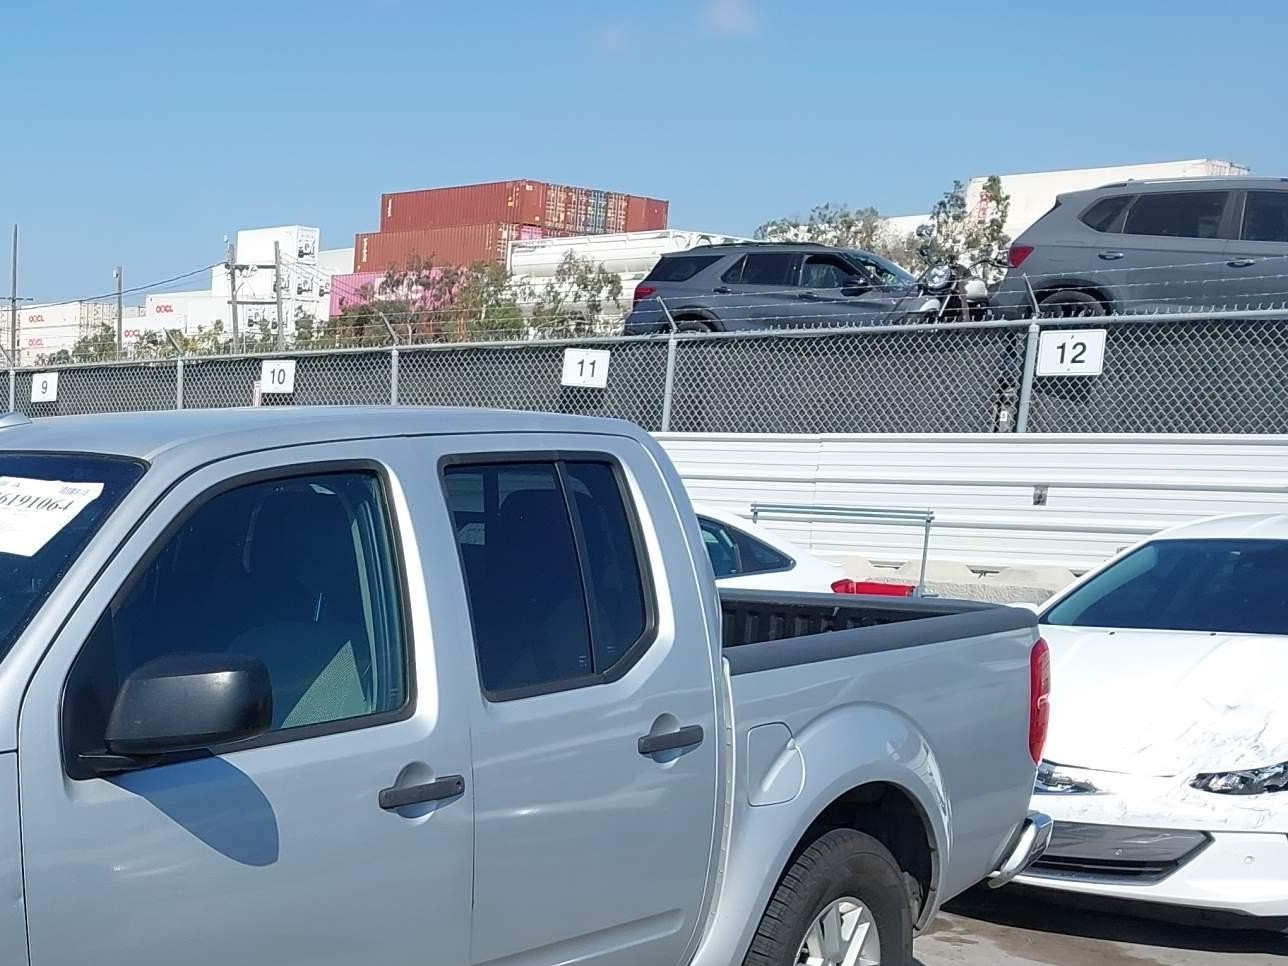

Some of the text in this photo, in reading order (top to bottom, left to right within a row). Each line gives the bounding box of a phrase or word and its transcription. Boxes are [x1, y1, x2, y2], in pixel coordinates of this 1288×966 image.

[1056, 342, 1088, 364] 12
[270, 368, 286, 385] 10
[577, 359, 596, 378] 11
[41, 380, 48, 394] 9
